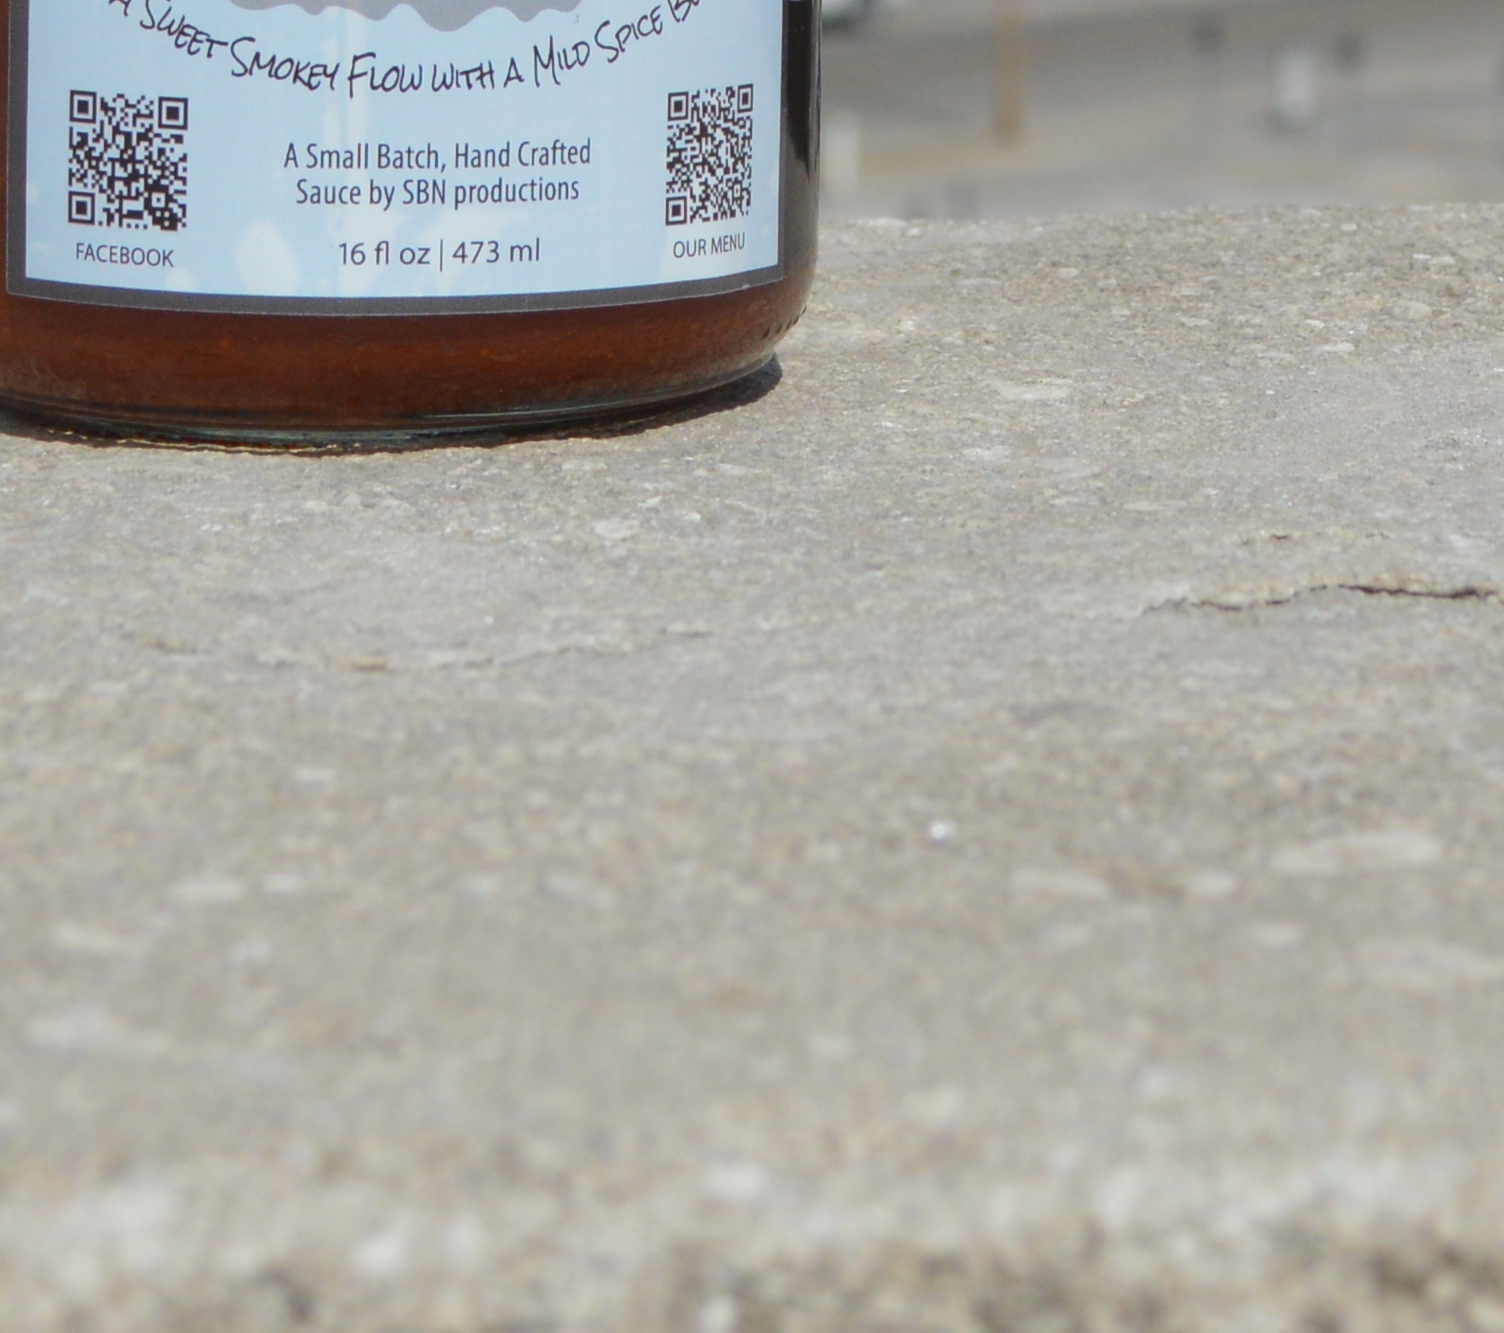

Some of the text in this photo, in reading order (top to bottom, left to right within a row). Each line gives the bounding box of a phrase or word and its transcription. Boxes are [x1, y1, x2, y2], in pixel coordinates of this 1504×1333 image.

[503, 57, 525, 88] A
[284, 137, 591, 173] A Small Batch, Hand Crafted
[296, 176, 580, 211] Sauce by SBN productions
[75, 242, 175, 268] FACEBOOK
[338, 241, 366, 266] 16
[374, 239, 390, 265] fl
[399, 246, 431, 265] oz
[452, 240, 501, 265] 473
[509, 236, 541, 262] ml
[673, 231, 746, 258] OUR MENU
